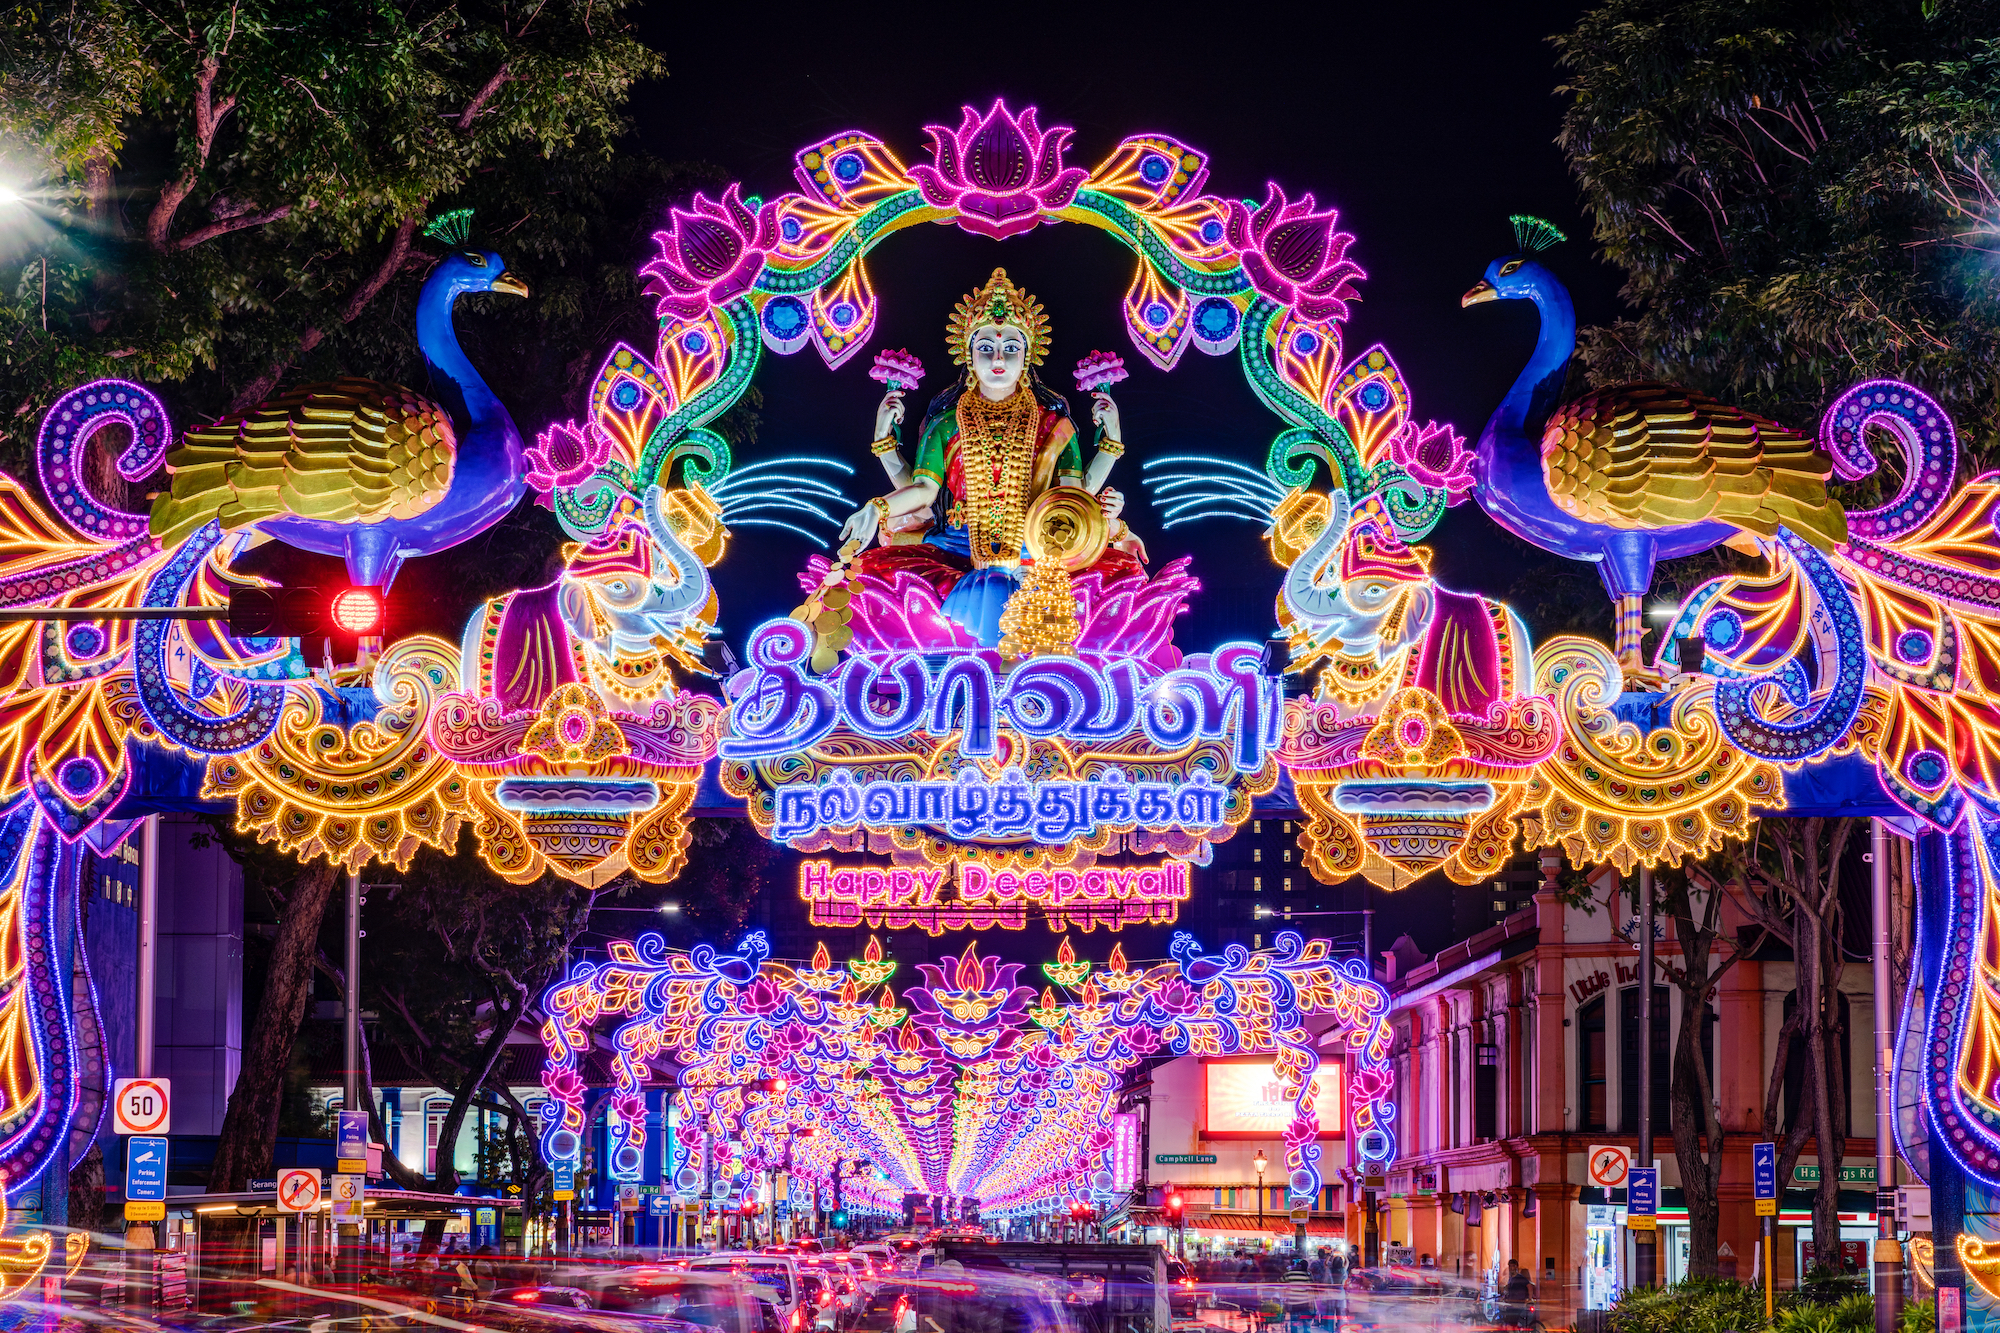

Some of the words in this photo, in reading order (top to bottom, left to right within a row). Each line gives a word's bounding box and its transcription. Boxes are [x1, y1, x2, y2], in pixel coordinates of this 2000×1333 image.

[174, 646, 186, 662] 4
[717, 616, 1284, 772] தீபாவளி
[800, 860, 946, 906] Happy
[958, 858, 1192, 906] Deepavali
[1568, 970, 1610, 1004] Little
[1614, 958, 1657, 984] Ind
[131, 1096, 153, 1116] 50
[1159, 1155, 1194, 1163] Campbell
[1860, 1168, 1874, 1178] Rd
[252, 1181, 277, 1189] Serang
